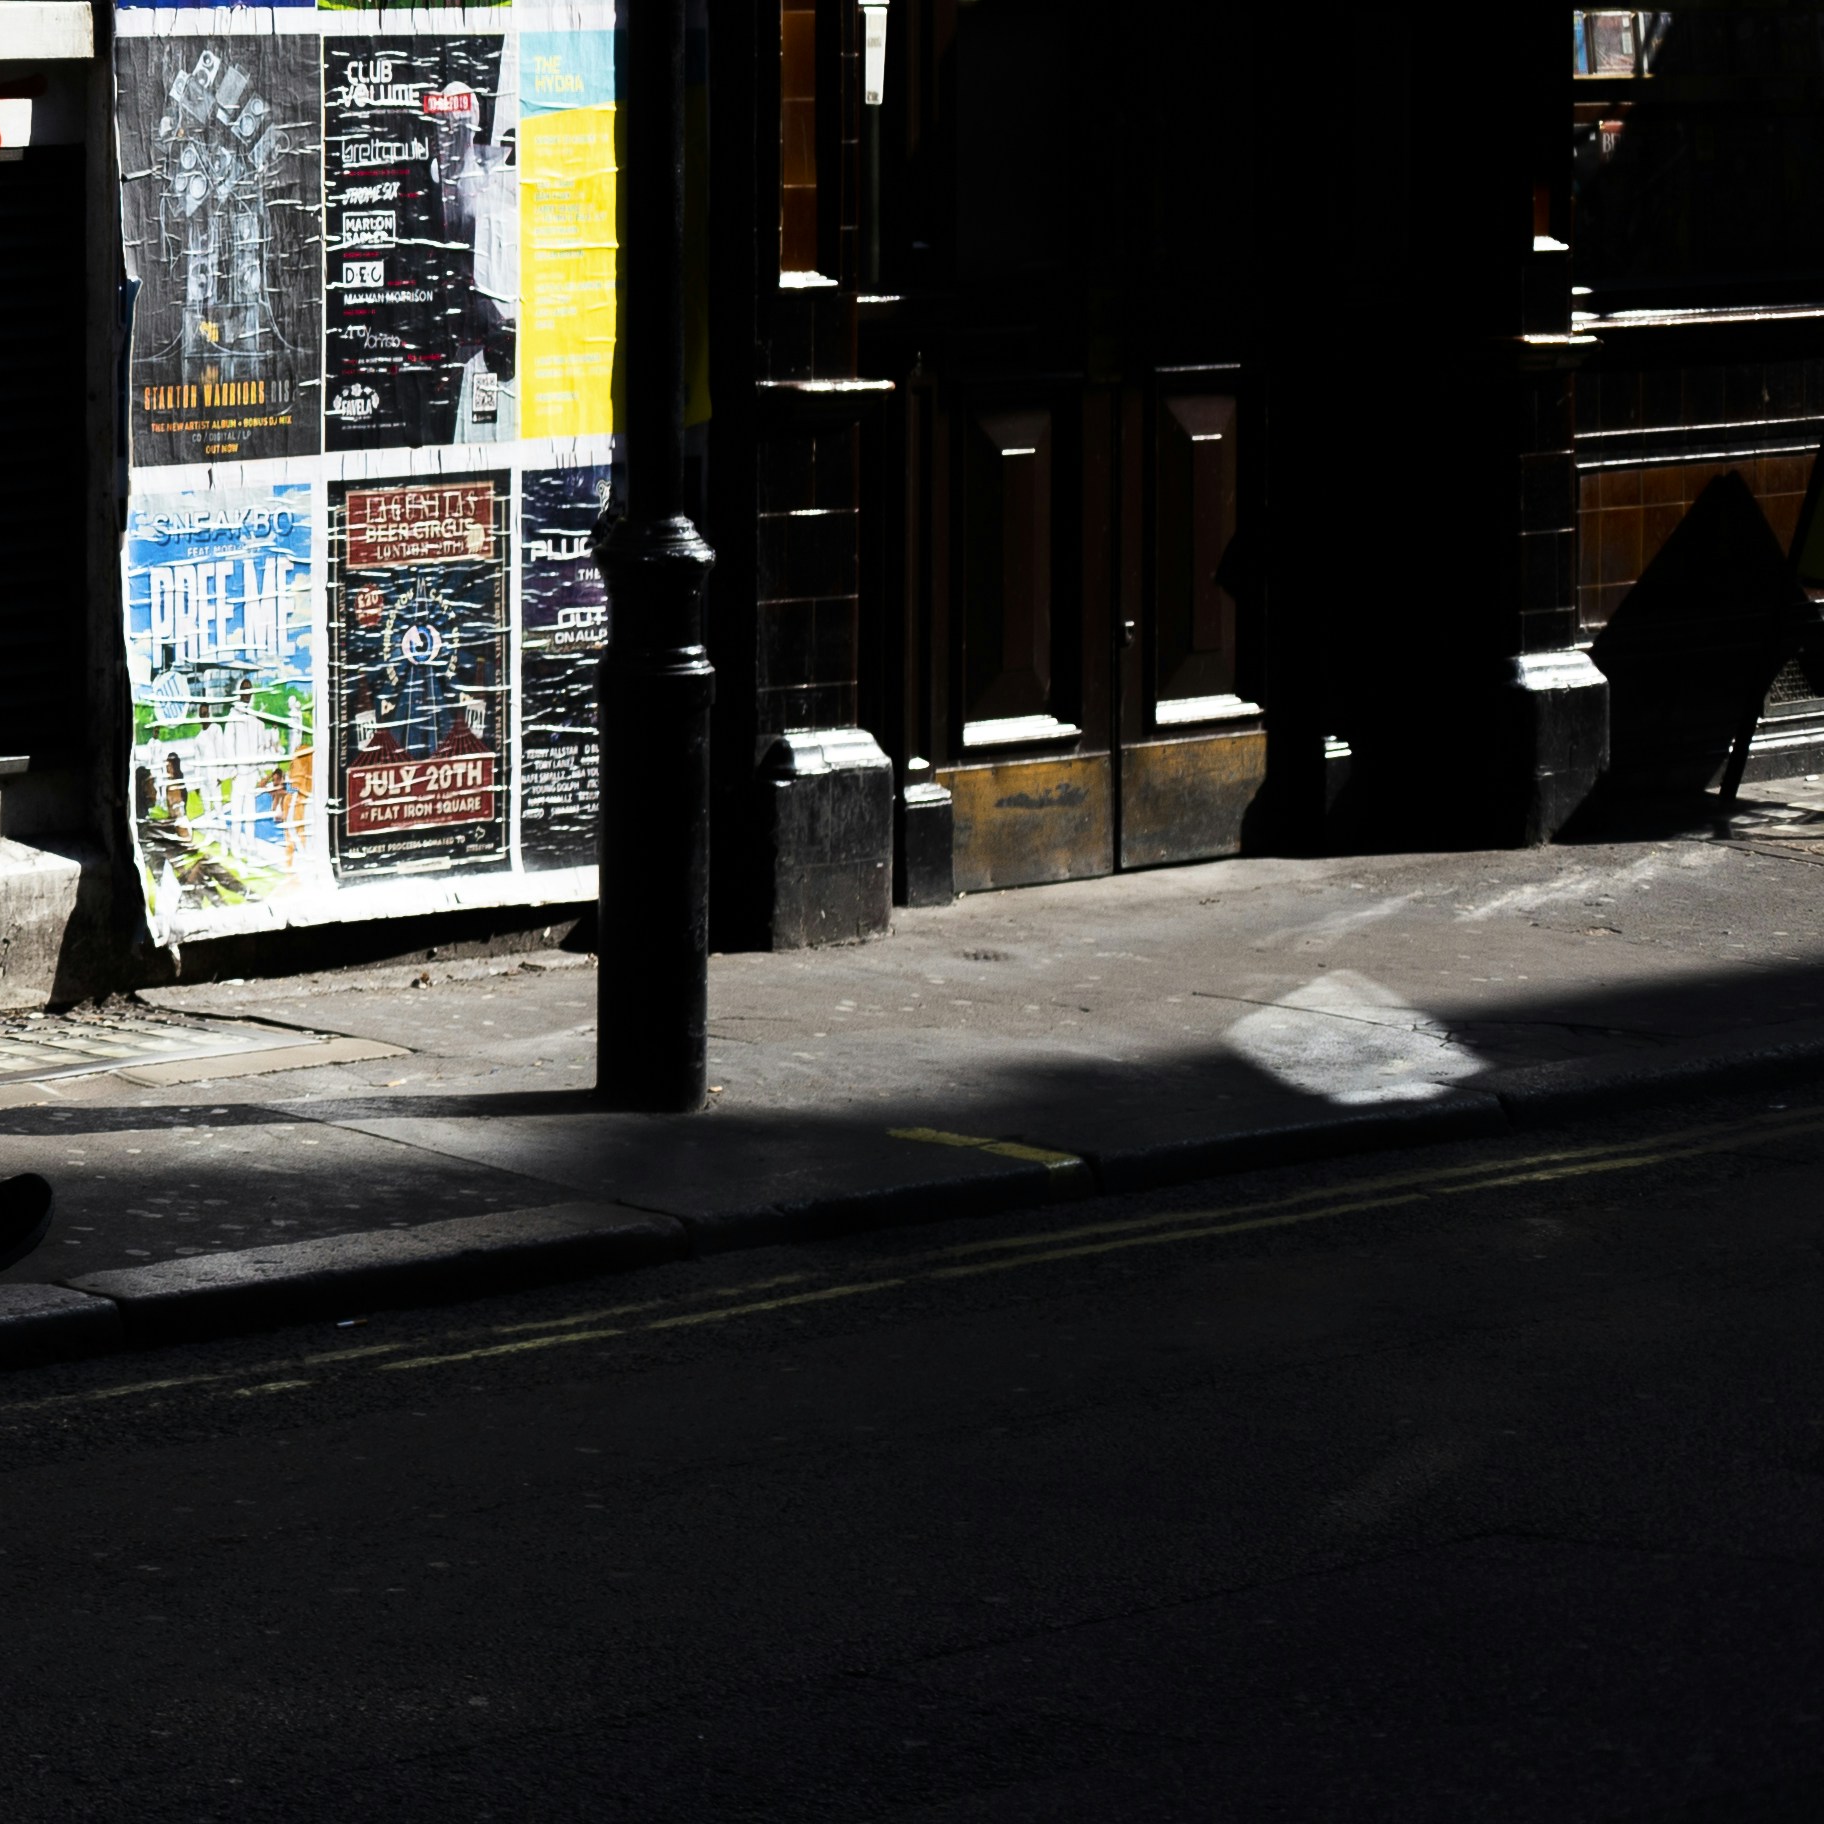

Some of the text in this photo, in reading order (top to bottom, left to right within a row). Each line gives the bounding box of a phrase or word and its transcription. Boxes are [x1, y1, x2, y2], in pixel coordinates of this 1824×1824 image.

[347, 59, 393, 84] CLUB
[152, 505, 295, 547] SNEAKBO
[365, 522, 409, 544] BEER
[242, 554, 296, 661] ME
[359, 766, 418, 799] JULY
[426, 760, 483, 792] 20TH
[370, 796, 482, 822] FLAT IRON SQUARE
